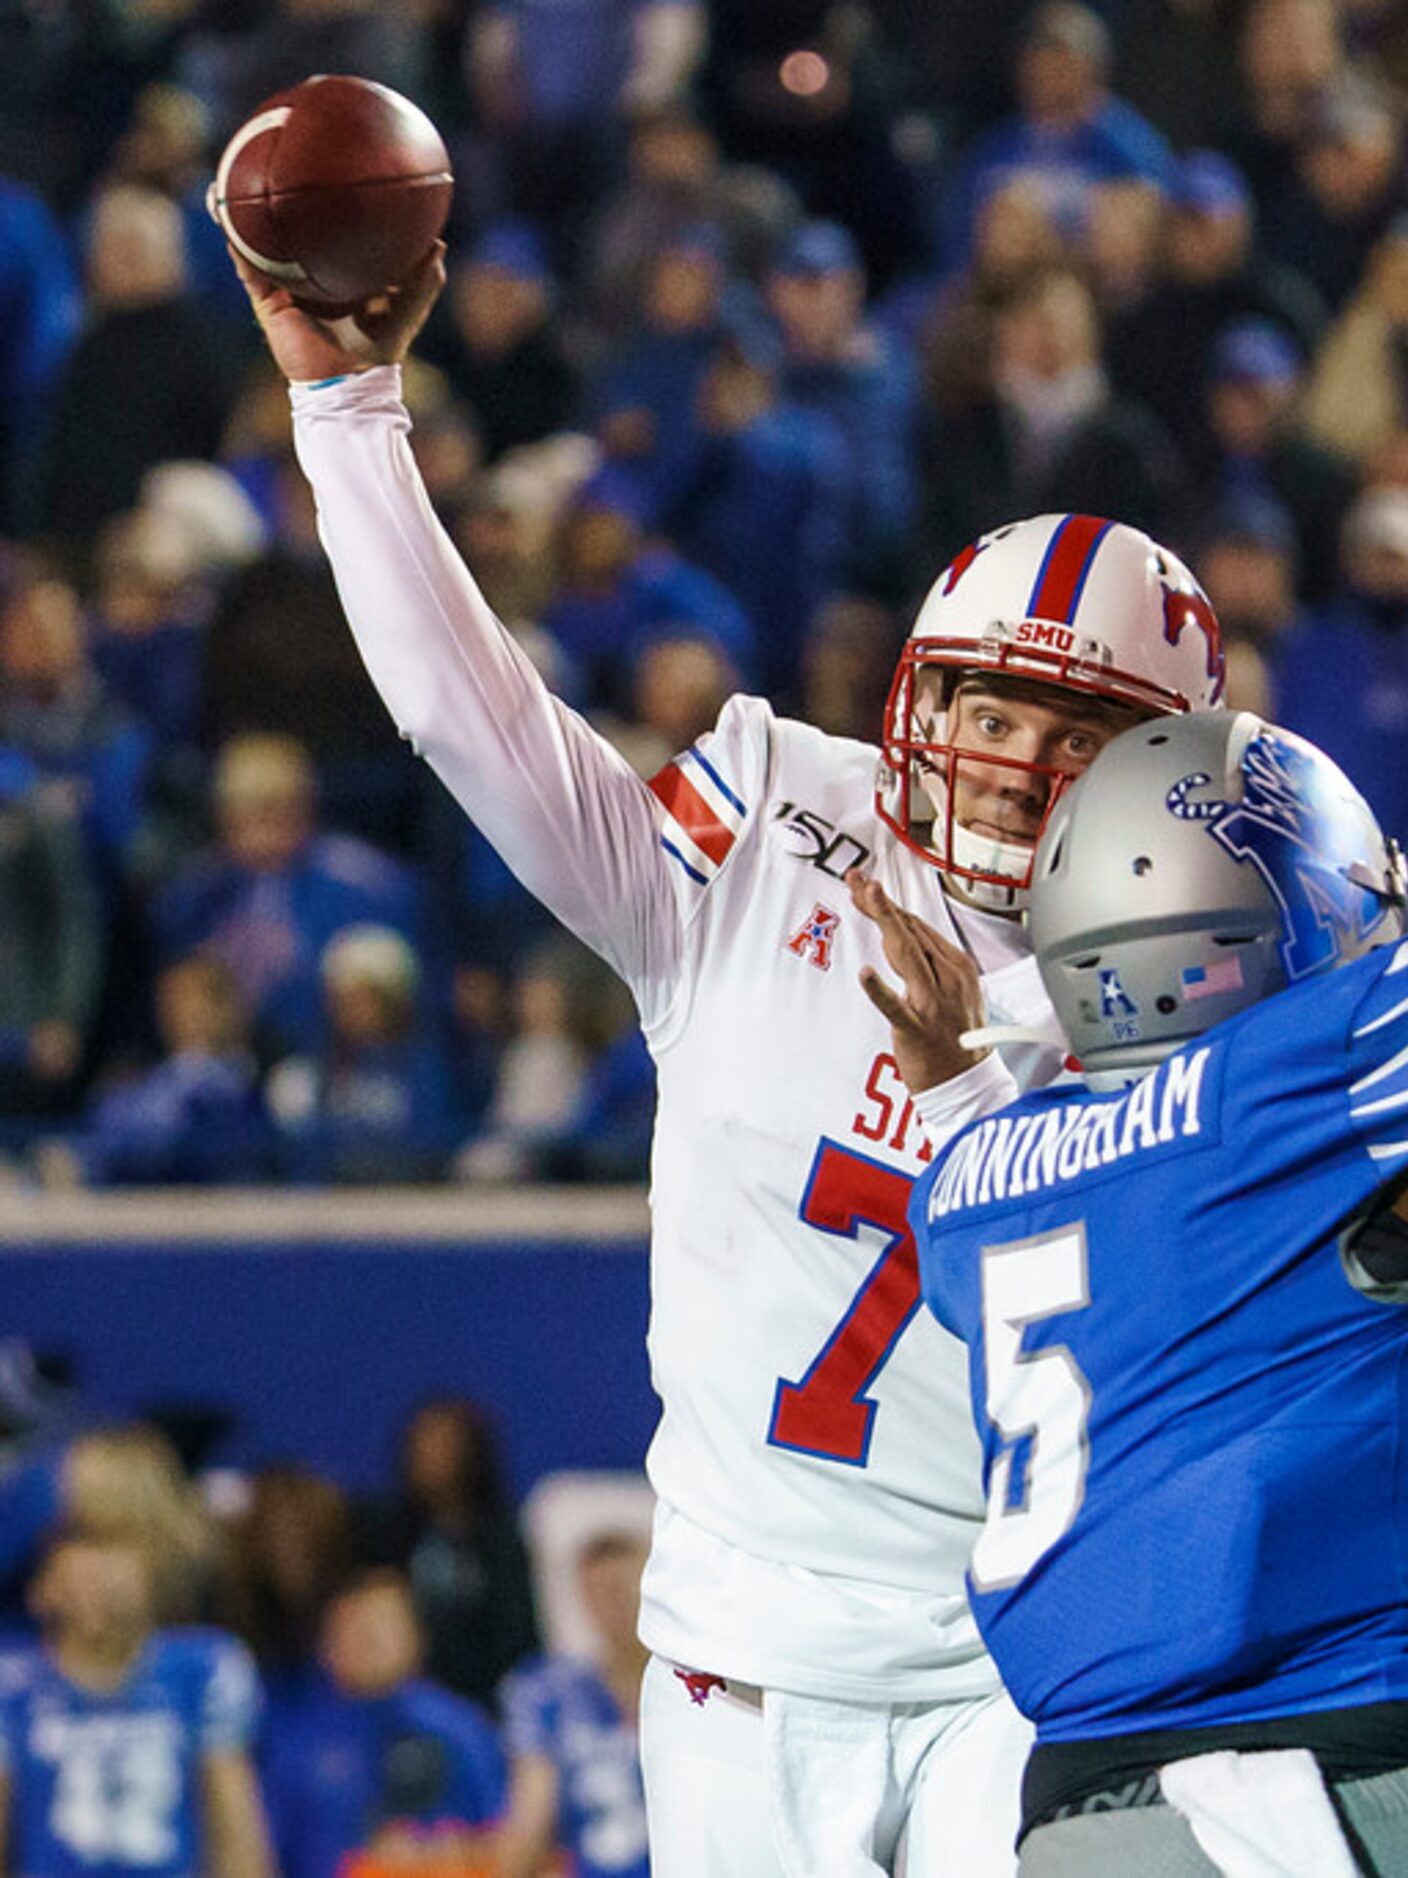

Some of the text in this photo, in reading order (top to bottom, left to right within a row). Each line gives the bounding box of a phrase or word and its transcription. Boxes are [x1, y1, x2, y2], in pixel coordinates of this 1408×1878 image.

[1016, 621, 1075, 653] SMU
[767, 1135, 923, 1468] 7
[964, 1219, 1093, 1595] 5
